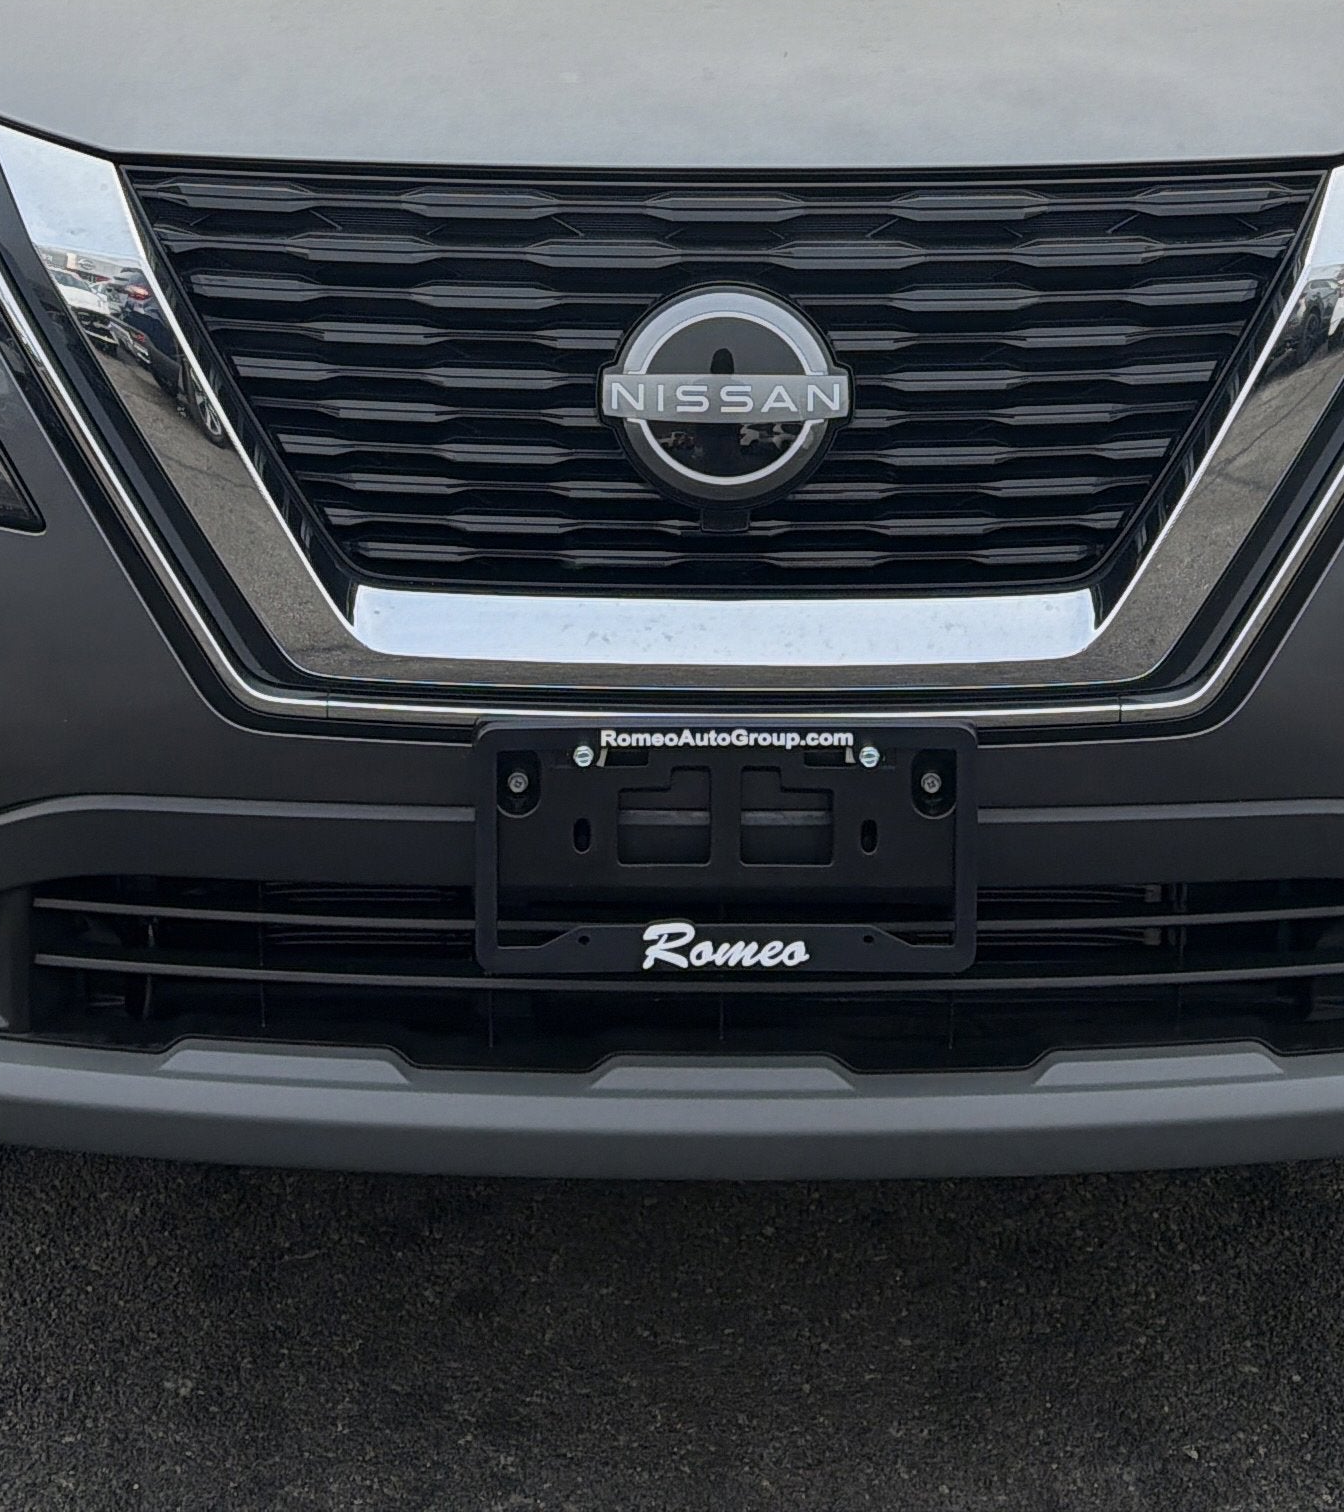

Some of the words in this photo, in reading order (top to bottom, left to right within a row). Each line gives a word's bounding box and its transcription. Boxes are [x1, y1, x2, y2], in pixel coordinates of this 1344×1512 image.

[611, 382, 840, 414] NISSAN
[600, 729, 854, 749] RomeoAutoGroup.com
[642, 922, 811, 971] Romeo
